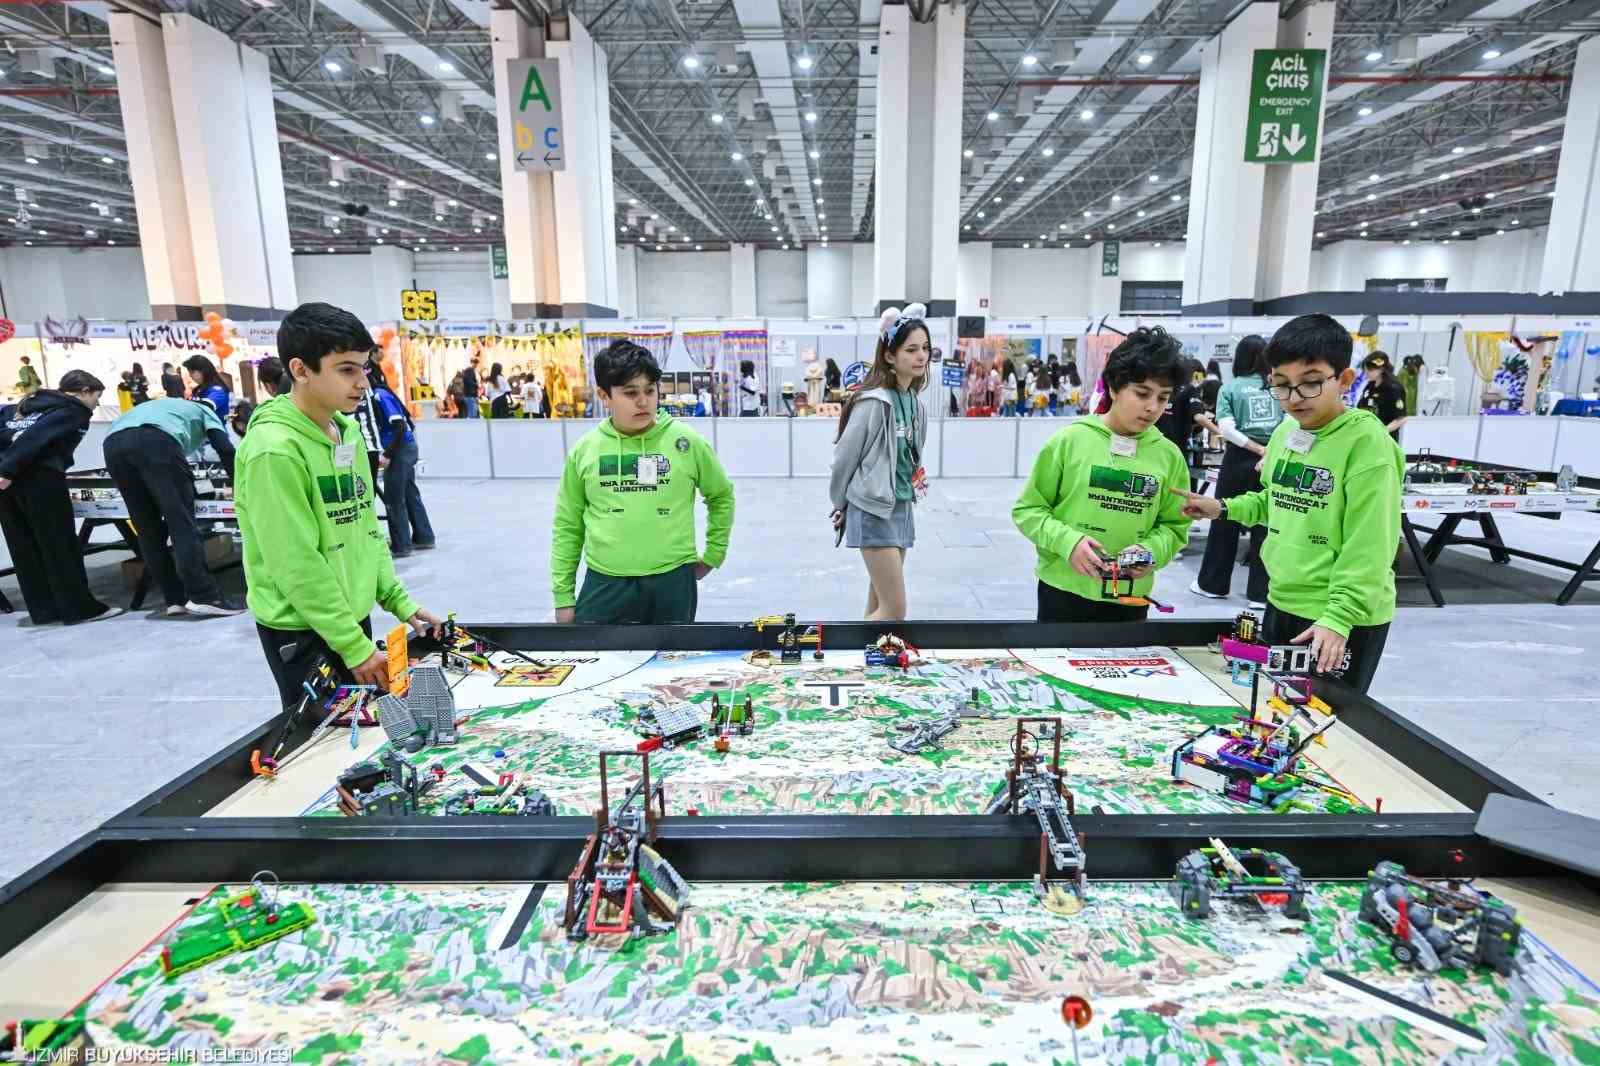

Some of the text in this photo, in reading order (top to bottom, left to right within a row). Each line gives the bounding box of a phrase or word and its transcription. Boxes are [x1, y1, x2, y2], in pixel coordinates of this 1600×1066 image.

[1270, 53, 1307, 71] ACİL
[519, 65, 552, 112] A
[1265, 74, 1309, 91] ÇIKIŞ
[1259, 97, 1312, 106] EMERGENCY
[1275, 107, 1294, 116] EXIT
[516, 119, 560, 150] b c
[130, 324, 206, 351] NEXUR
